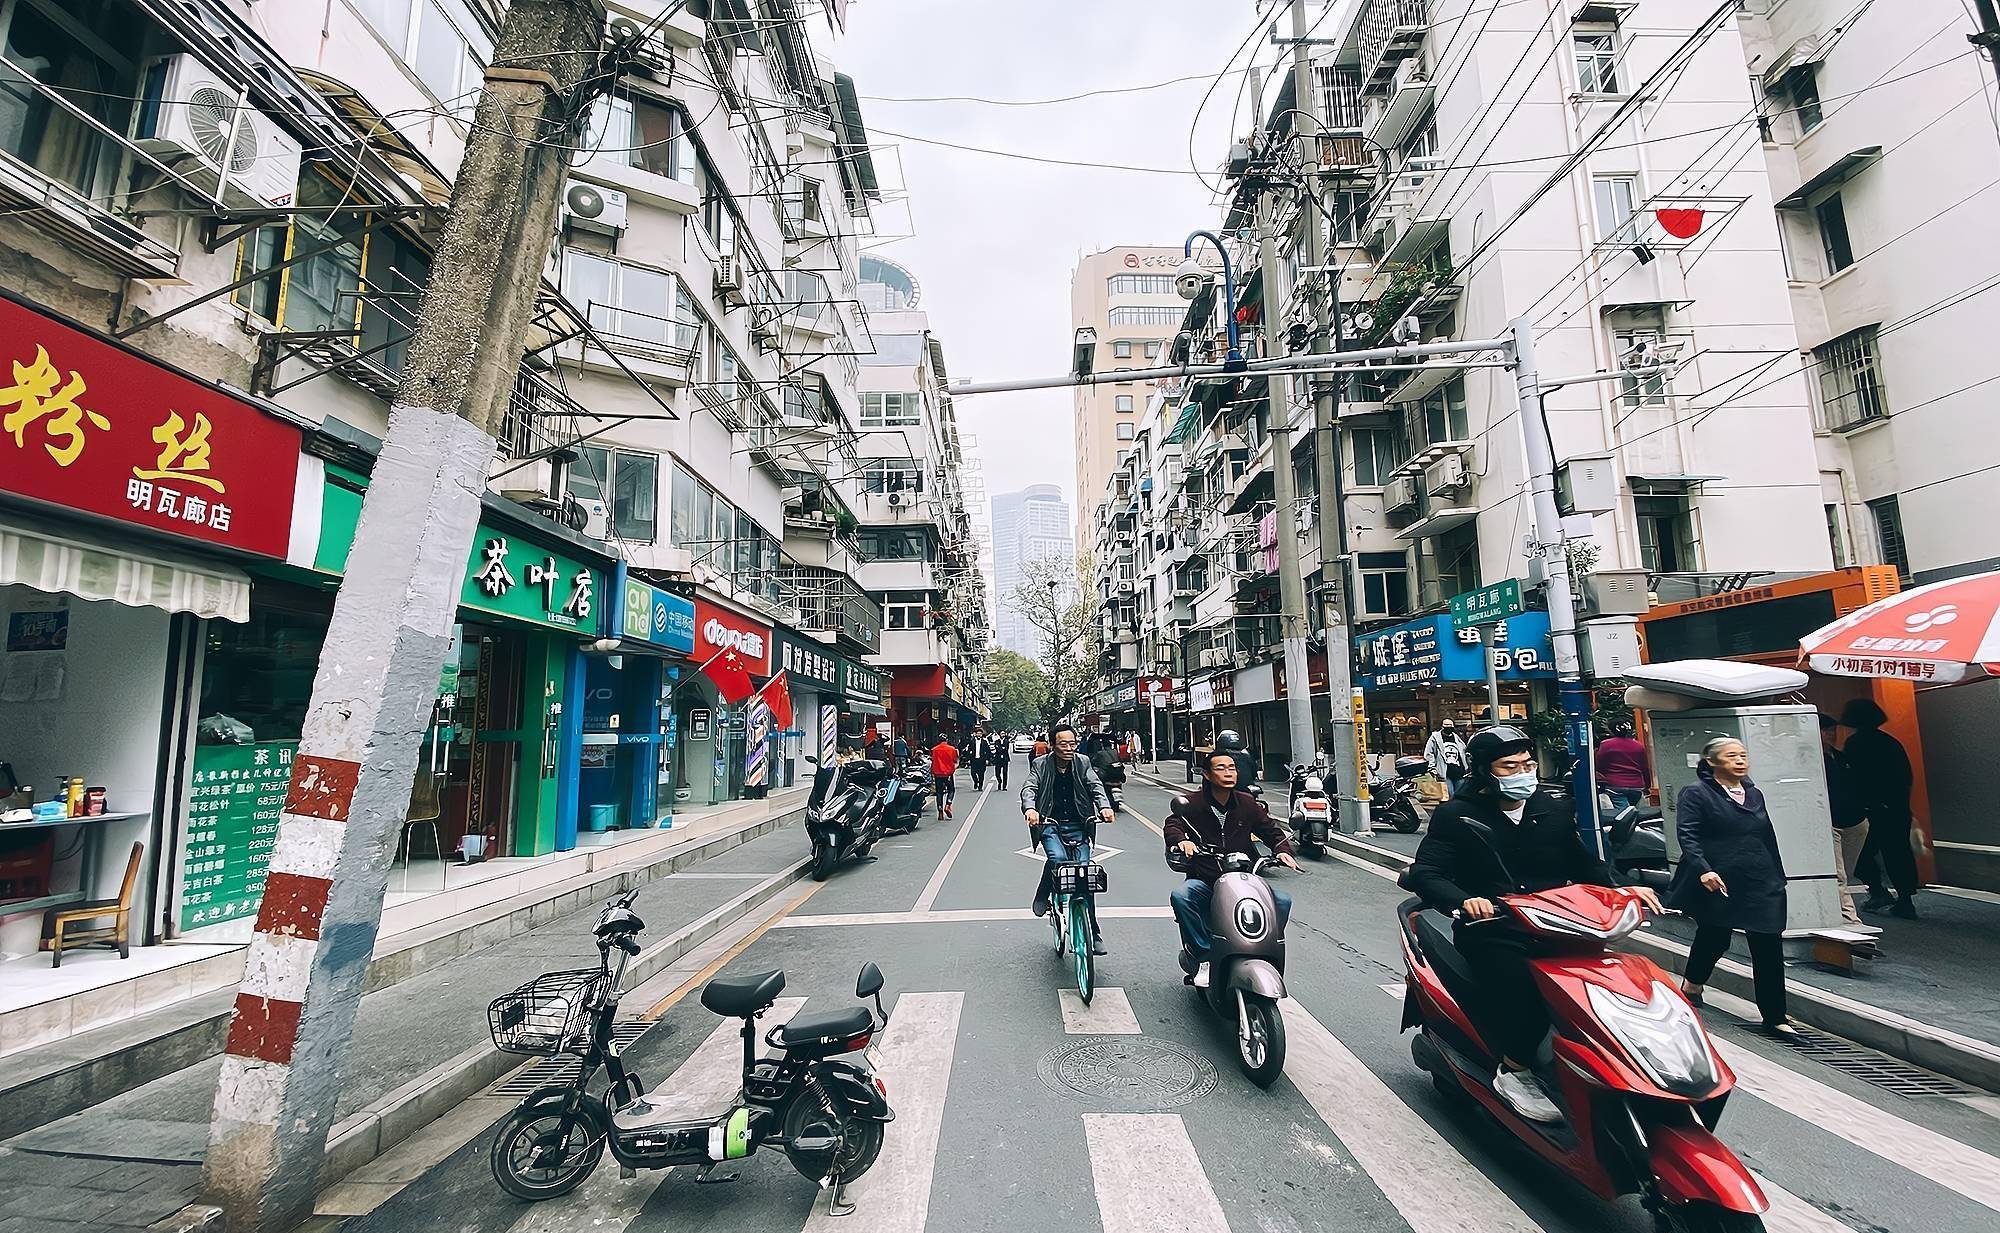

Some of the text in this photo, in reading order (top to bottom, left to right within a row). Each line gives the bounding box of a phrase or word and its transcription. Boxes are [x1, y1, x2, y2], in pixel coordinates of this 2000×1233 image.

[126, 478, 232, 532] 明瓦廊店
[474, 537, 593, 618] 茶叶店
[1466, 589, 1500, 612] 明瓦廊
[1831, 657, 1936, 680] 小初高1对1辅导
[441, 694, 456, 709] 推
[550, 702, 562, 715] 推
